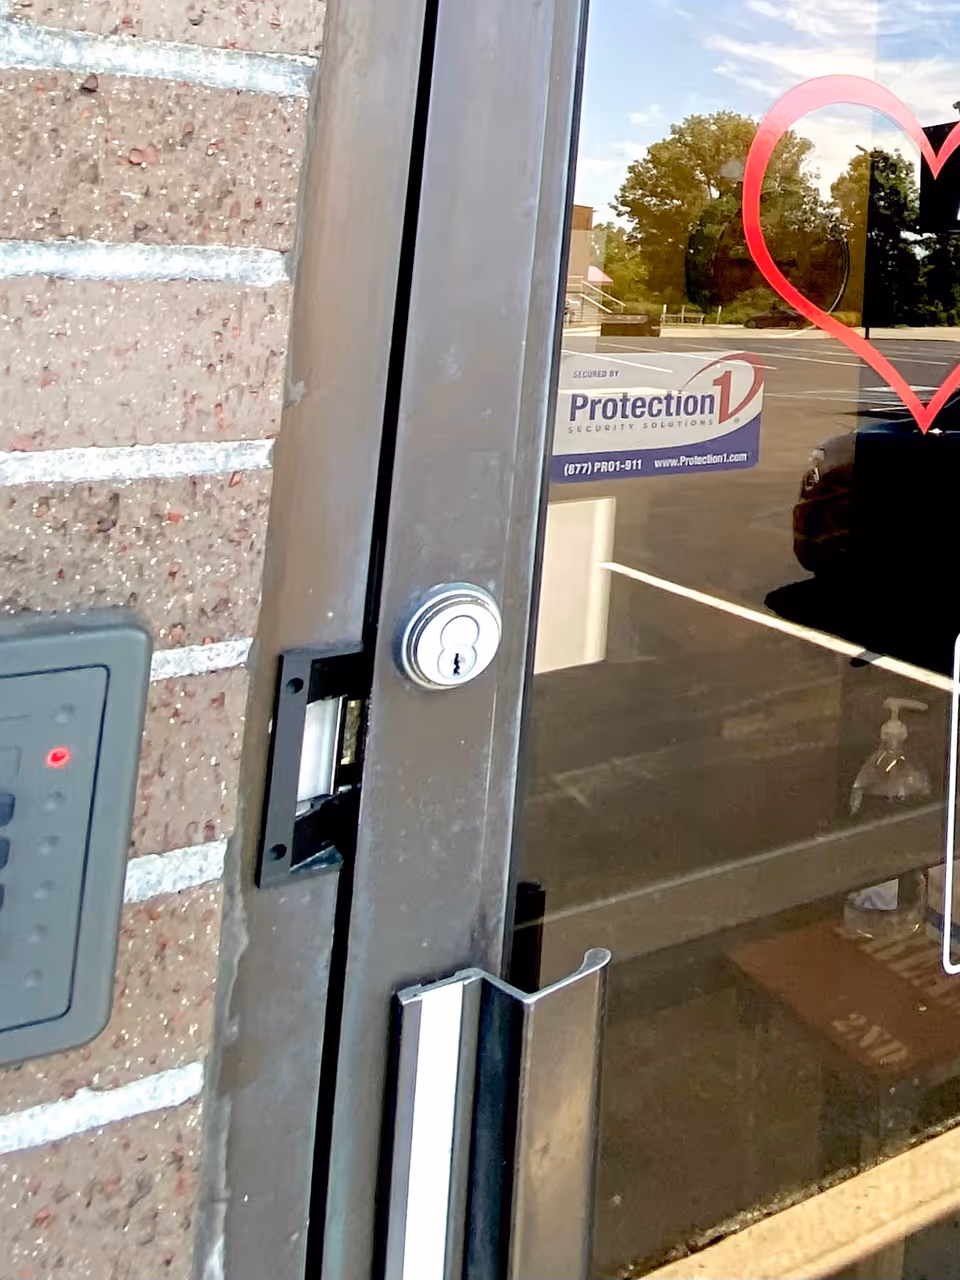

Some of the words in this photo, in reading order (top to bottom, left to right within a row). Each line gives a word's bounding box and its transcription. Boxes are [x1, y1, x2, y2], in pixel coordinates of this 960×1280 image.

[573, 370, 607, 379] SECURED
[569, 390, 715, 421] Protection
[568, 423, 635, 434] SECURITY
[642, 419, 714, 430] SOLUTIONS
[564, 462, 592, 476] (877)
